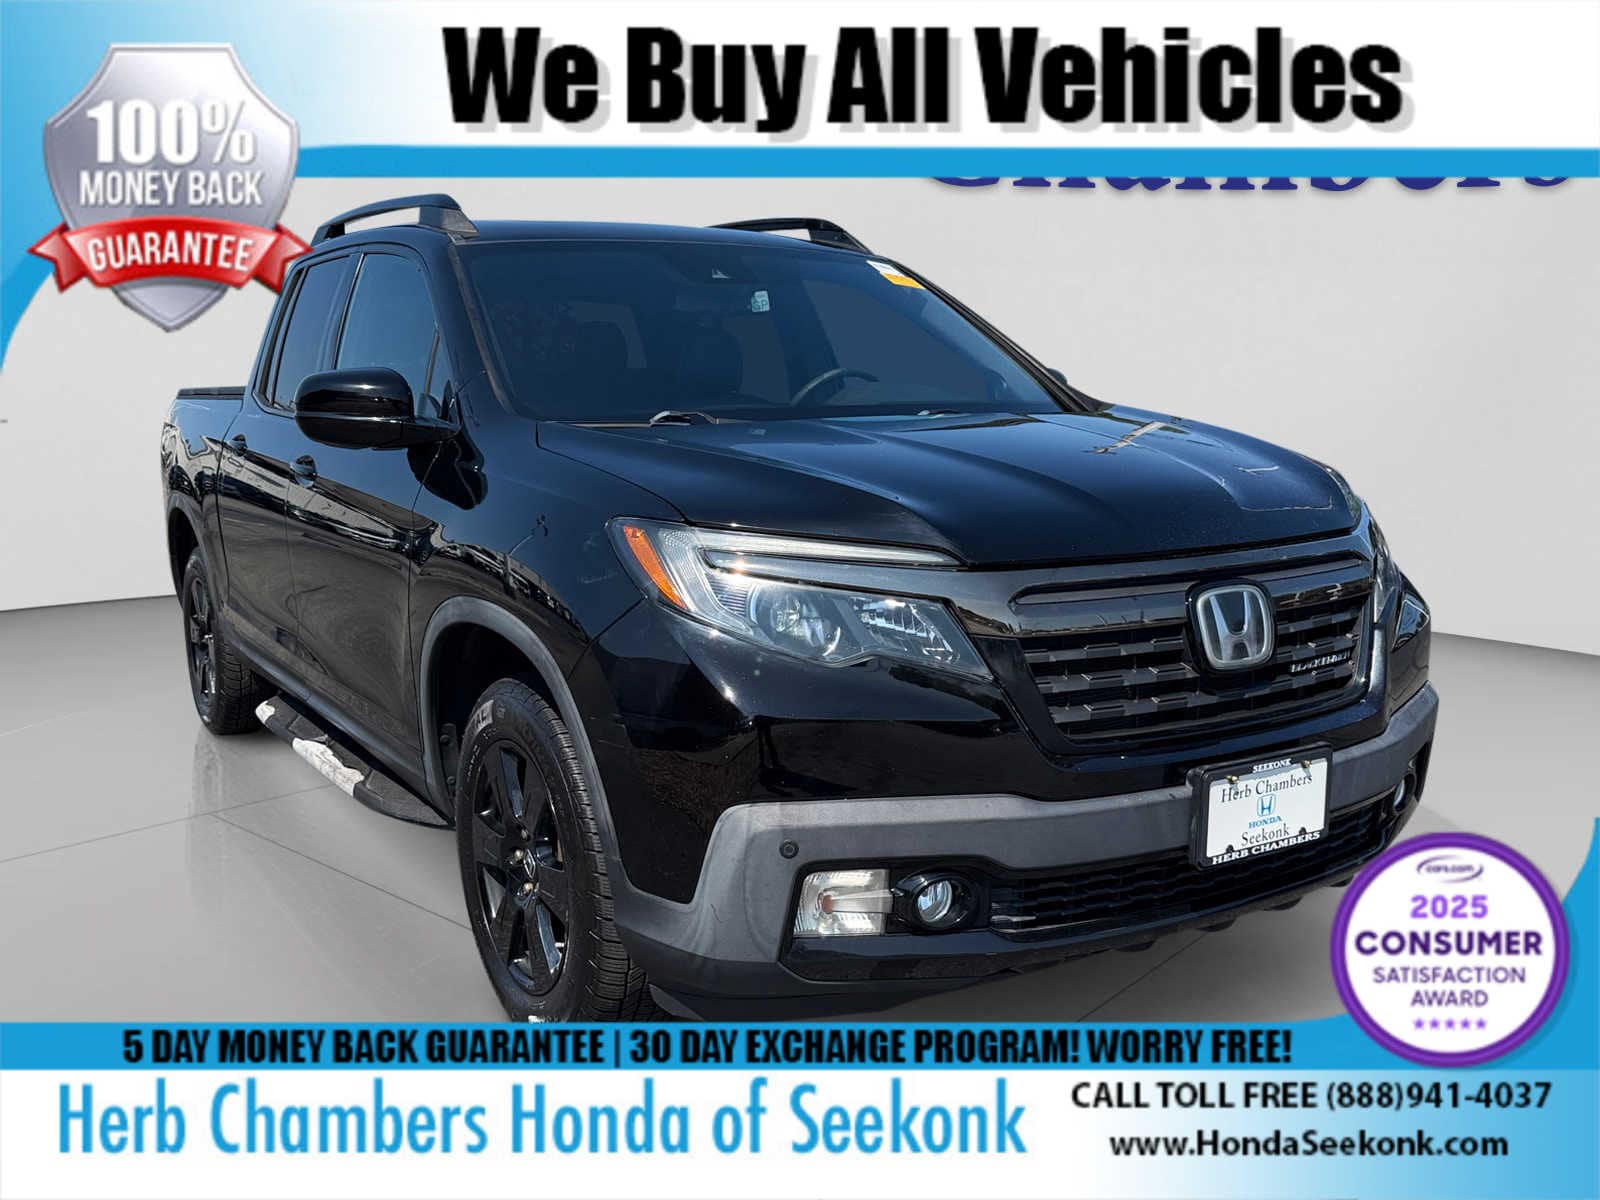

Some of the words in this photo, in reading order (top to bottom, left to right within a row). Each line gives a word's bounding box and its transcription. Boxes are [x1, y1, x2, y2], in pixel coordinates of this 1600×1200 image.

[1252, 758, 1292, 774] SEEKONK
[1221, 784, 1251, 803] Herb
[1255, 773, 1313, 796] Chambers
[1248, 815, 1282, 829] HONDA
[1241, 823, 1290, 847] Seekonk
[1212, 849, 1249, 865] HERB
[1251, 831, 1321, 855] CHAMBERS
